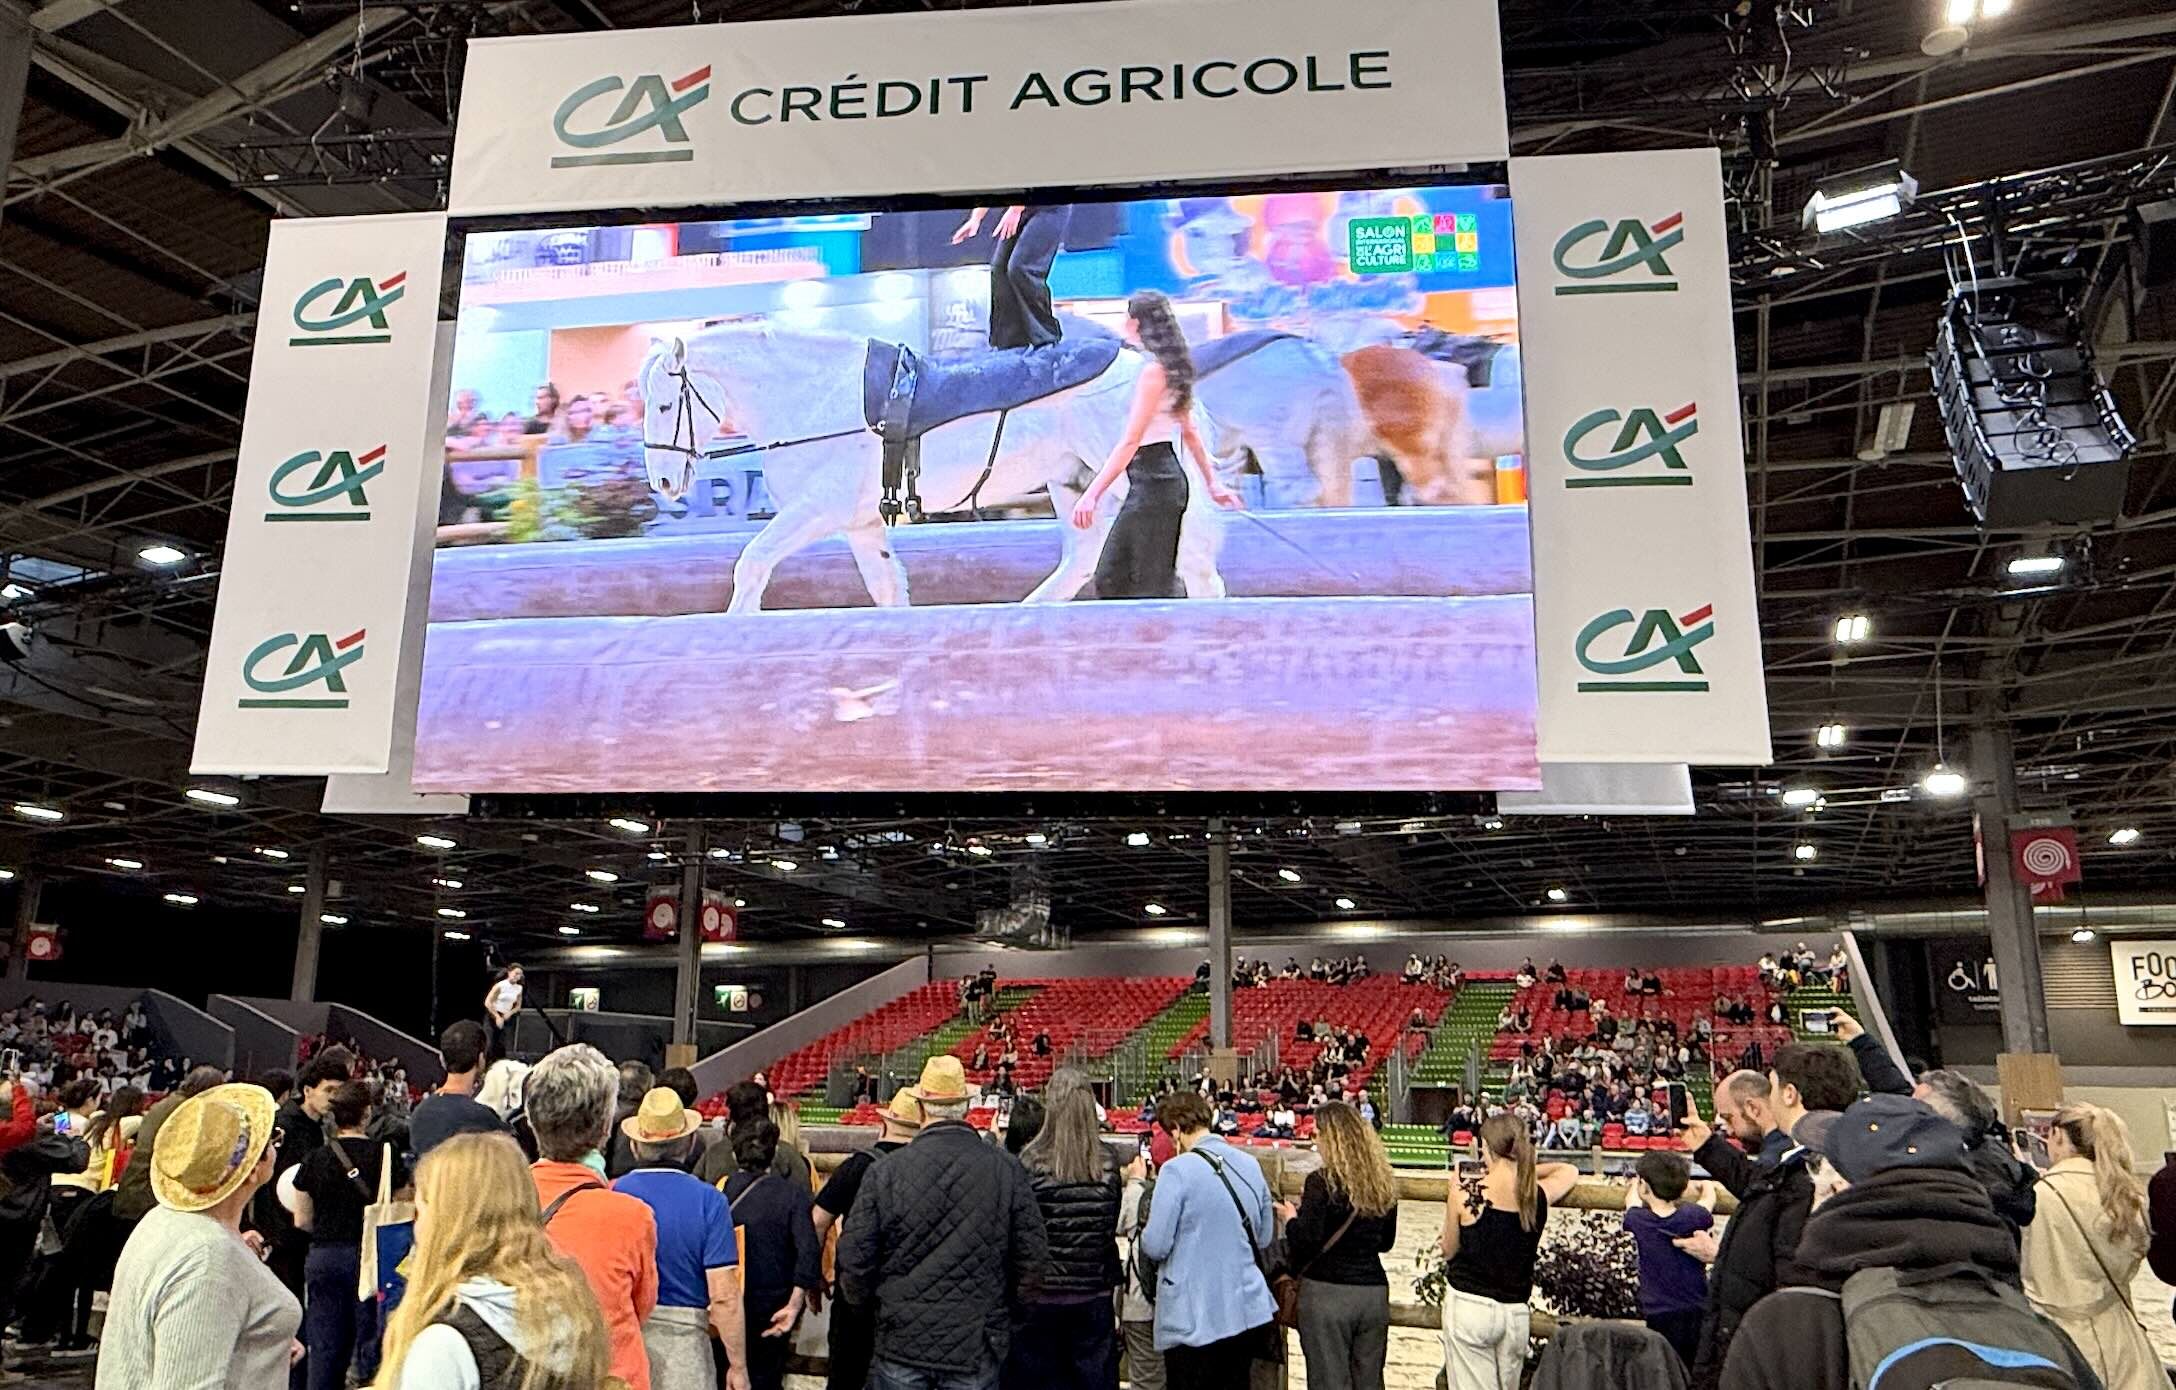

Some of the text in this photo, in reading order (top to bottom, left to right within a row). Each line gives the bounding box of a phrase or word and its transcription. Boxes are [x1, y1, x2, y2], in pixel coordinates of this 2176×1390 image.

[730, 73, 989, 125] CRÉDIT
[1009, 50, 1393, 111] AGRICOLE
[1355, 225, 1405, 239] SALON
[1356, 254, 1407, 267] CULTURE
